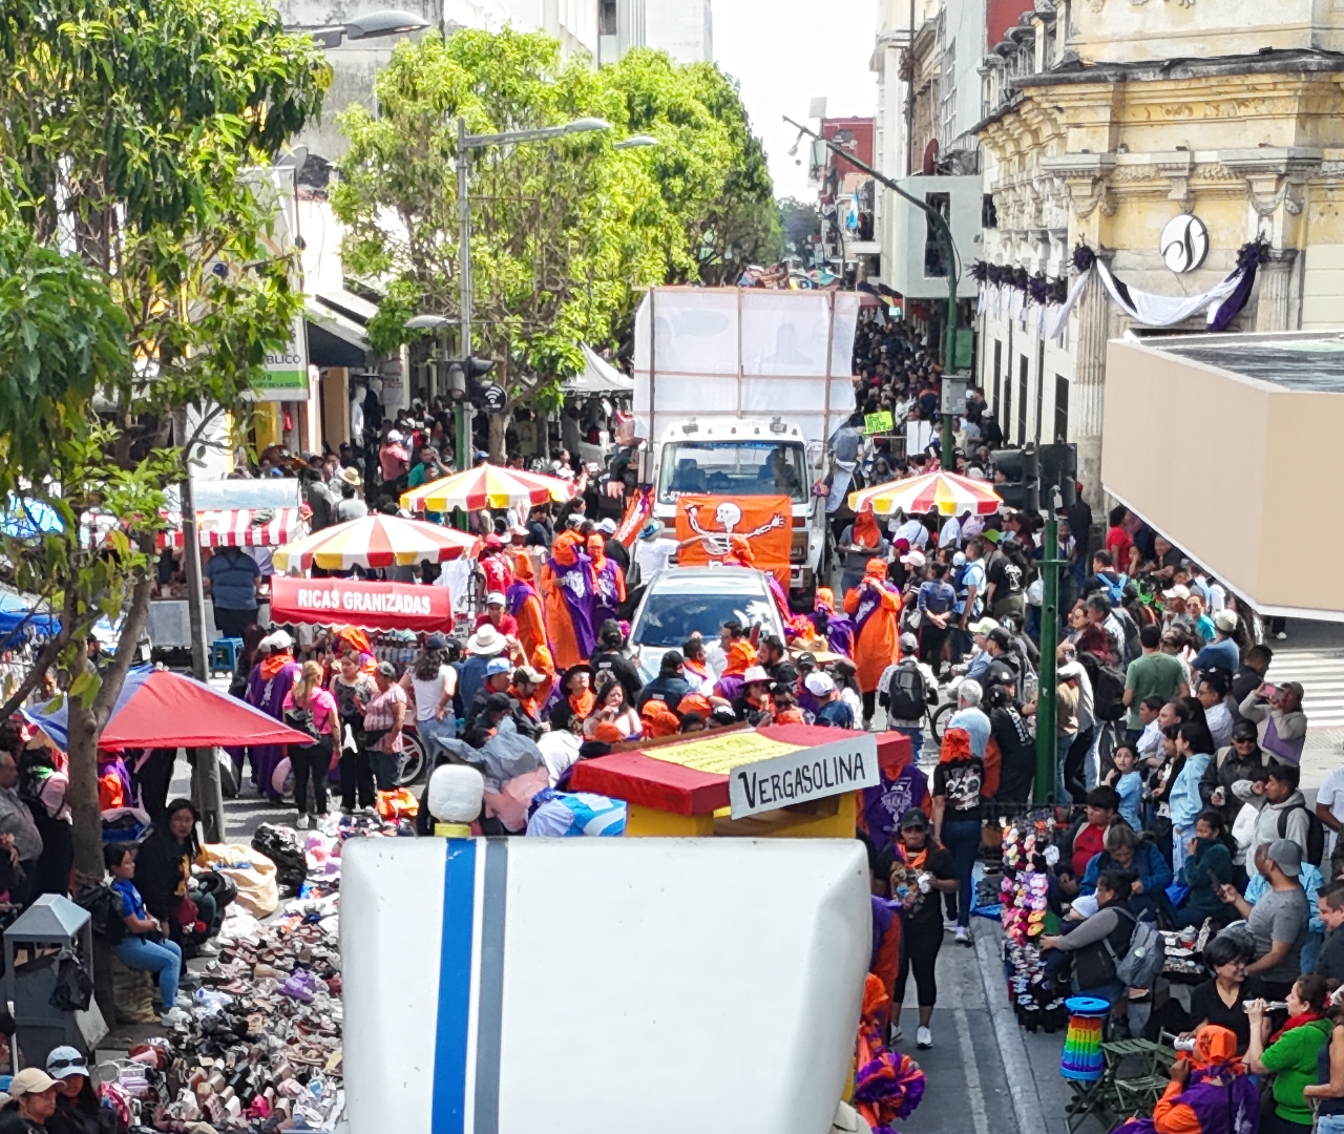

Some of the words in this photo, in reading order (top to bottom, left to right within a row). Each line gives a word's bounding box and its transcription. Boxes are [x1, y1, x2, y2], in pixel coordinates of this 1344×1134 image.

[297, 588, 341, 610] RICAS
[342, 591, 432, 615] GRANIZADAS
[737, 752, 866, 809] VERGASOLINA
